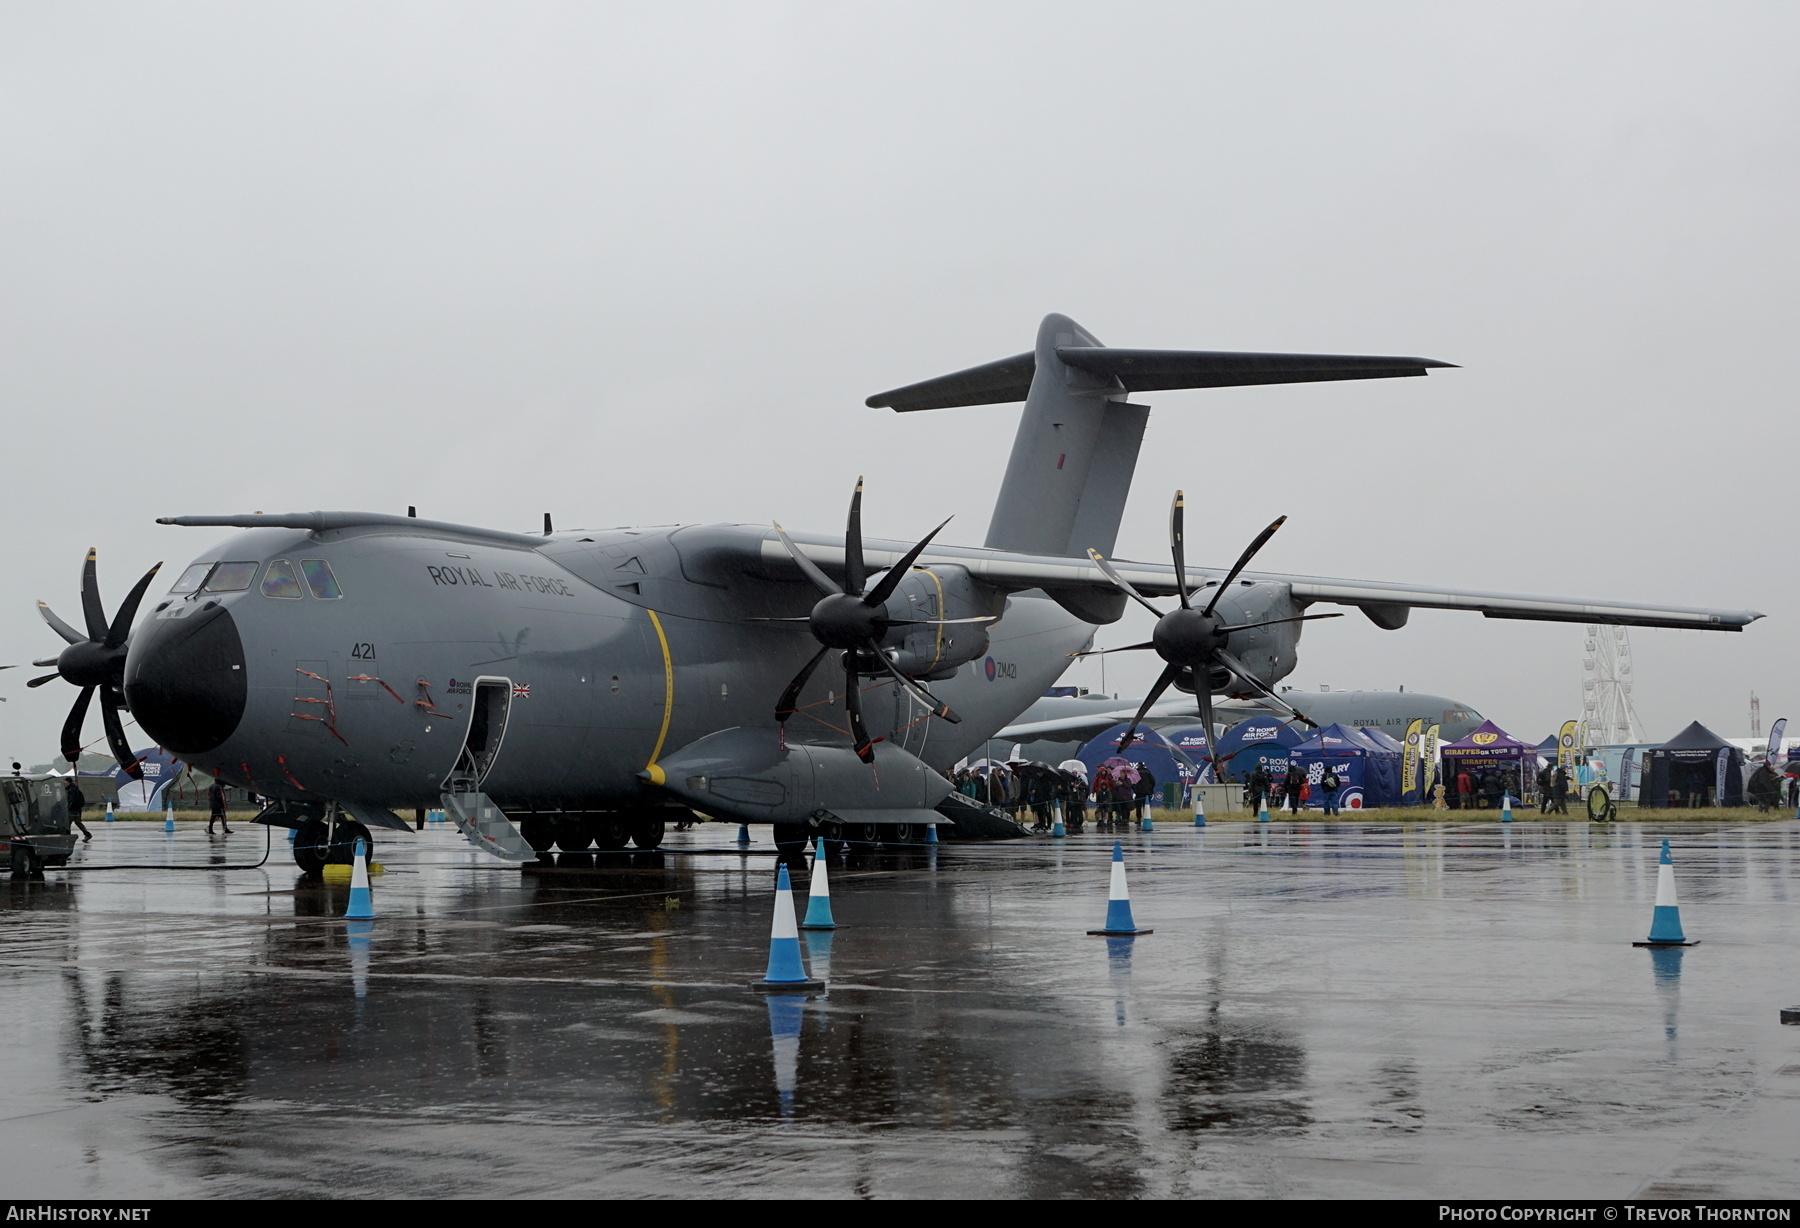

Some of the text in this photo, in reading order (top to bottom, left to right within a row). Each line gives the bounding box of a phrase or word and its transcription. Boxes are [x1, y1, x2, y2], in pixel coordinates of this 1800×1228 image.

[426, 565, 575, 597] ROYAL AIR FORCE
[351, 642, 376, 660] 421
[997, 661, 1017, 679] ZM421
[1353, 719, 1380, 727] ROYAL
[1386, 718, 1401, 726] AIR
[1309, 761, 1325, 771] NO
[1620, 789, 1626, 798] We
